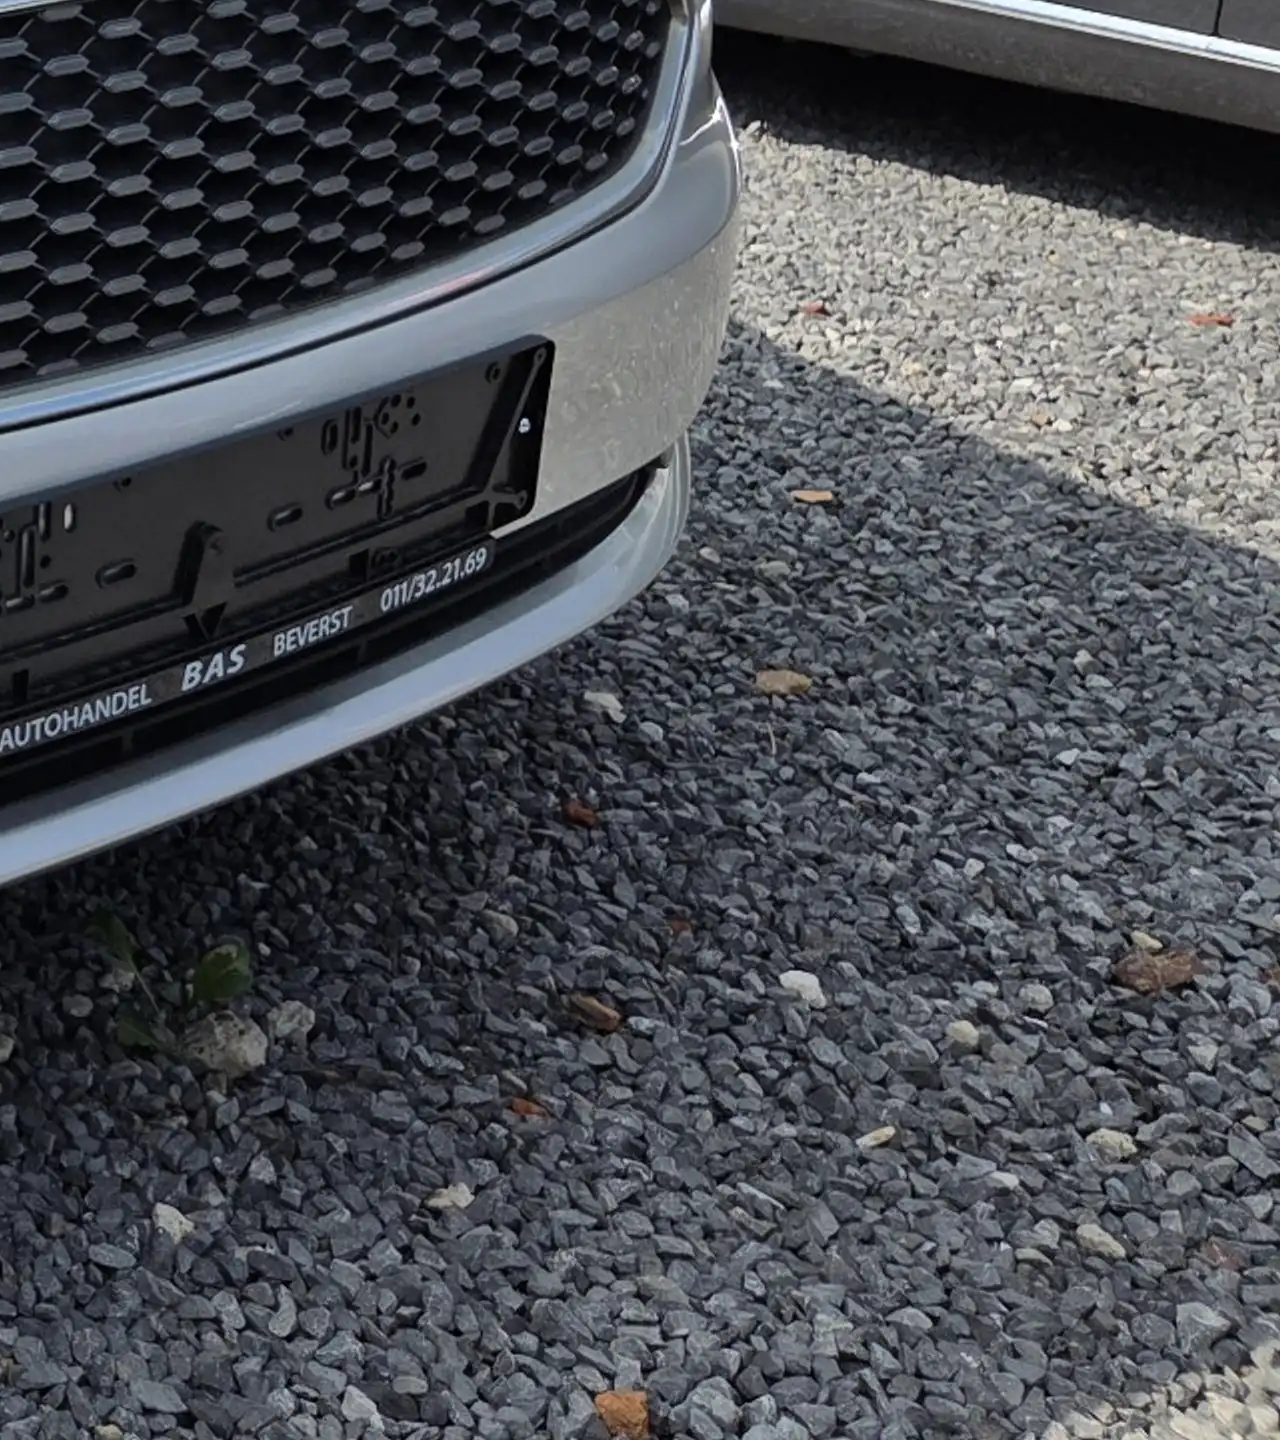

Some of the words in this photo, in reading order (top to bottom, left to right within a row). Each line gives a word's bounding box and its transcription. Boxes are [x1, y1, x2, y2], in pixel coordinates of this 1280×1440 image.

[180, 643, 247, 692] BAS
[272, 606, 354, 657] BEVERST
[379, 547, 488, 612] 011/32.21.69
